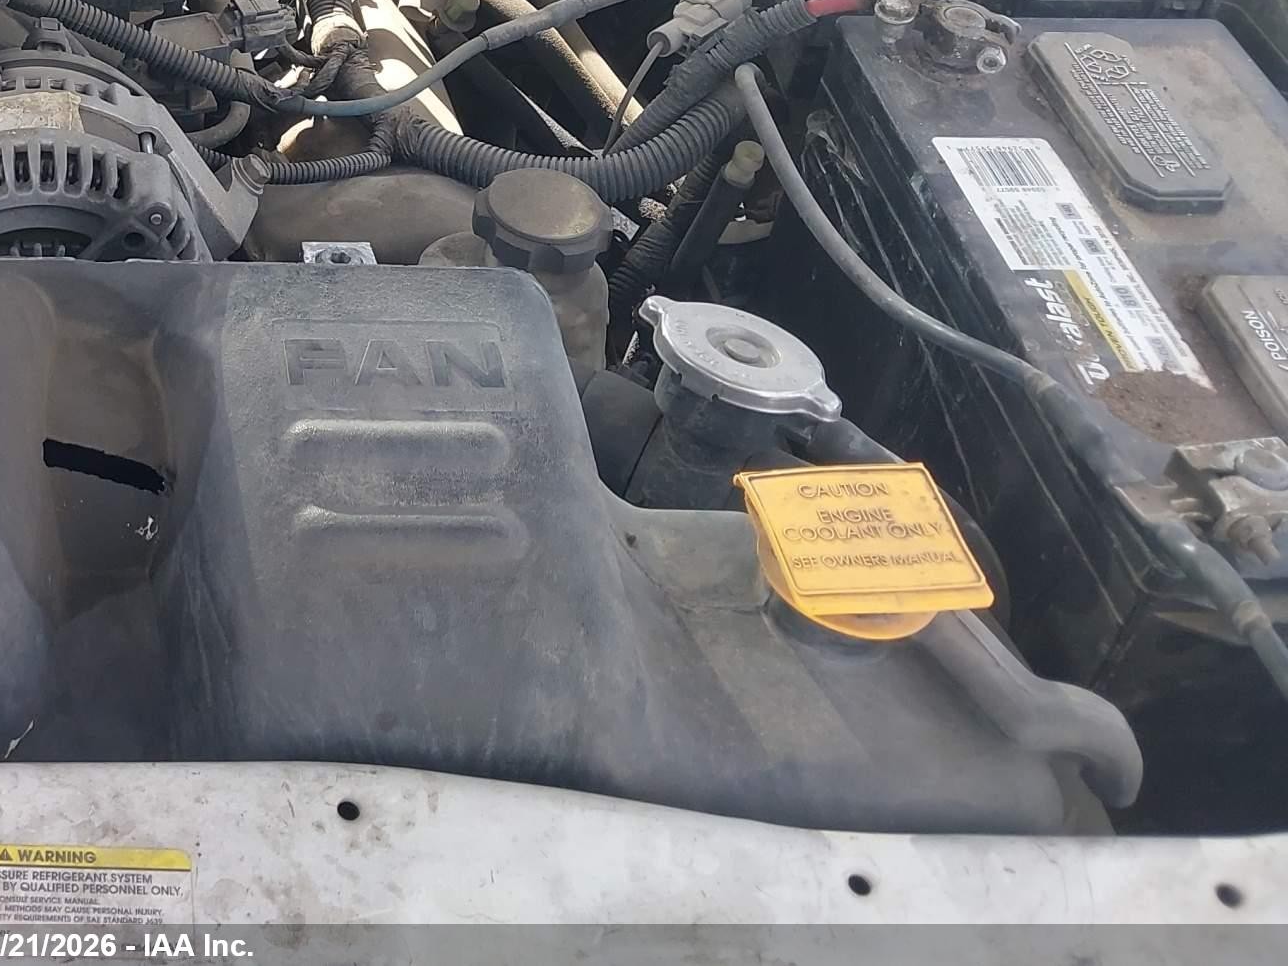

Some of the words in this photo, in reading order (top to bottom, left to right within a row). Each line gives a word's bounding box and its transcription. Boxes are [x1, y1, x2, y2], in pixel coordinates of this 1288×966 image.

[1113, 287, 1138, 307] 810
[1241, 310, 1288, 361] POISON
[283, 338, 507, 388] FAN
[797, 482, 889, 499] CAUTION
[817, 507, 895, 524] ENGINE
[783, 524, 882, 541] COOLANT
[886, 521, 943, 540] ONLY
[791, 553, 817, 570] SEE
[821, 553, 889, 569] OWNERS
[891, 550, 961, 567] MANUAL
[18, 849, 97, 863] WARNING
[32, 870, 108, 883] REFRIGERANT
[110, 873, 152, 884] SYSTEM
[3, 881, 18, 891] BY
[20, 881, 80, 893] QUALIFIED
[82, 883, 148, 895] PERSONNEL
[32, 896, 62, 905] SERVICE
[5, 904, 43, 913] METHODS
[44, 905, 63, 914] MAY
[64, 906, 90, 914] CAUSE
[93, 907, 132, 916] PERSONAL
[73, 915, 85, 923] OF
[103, 916, 144, 925] STANDARD
